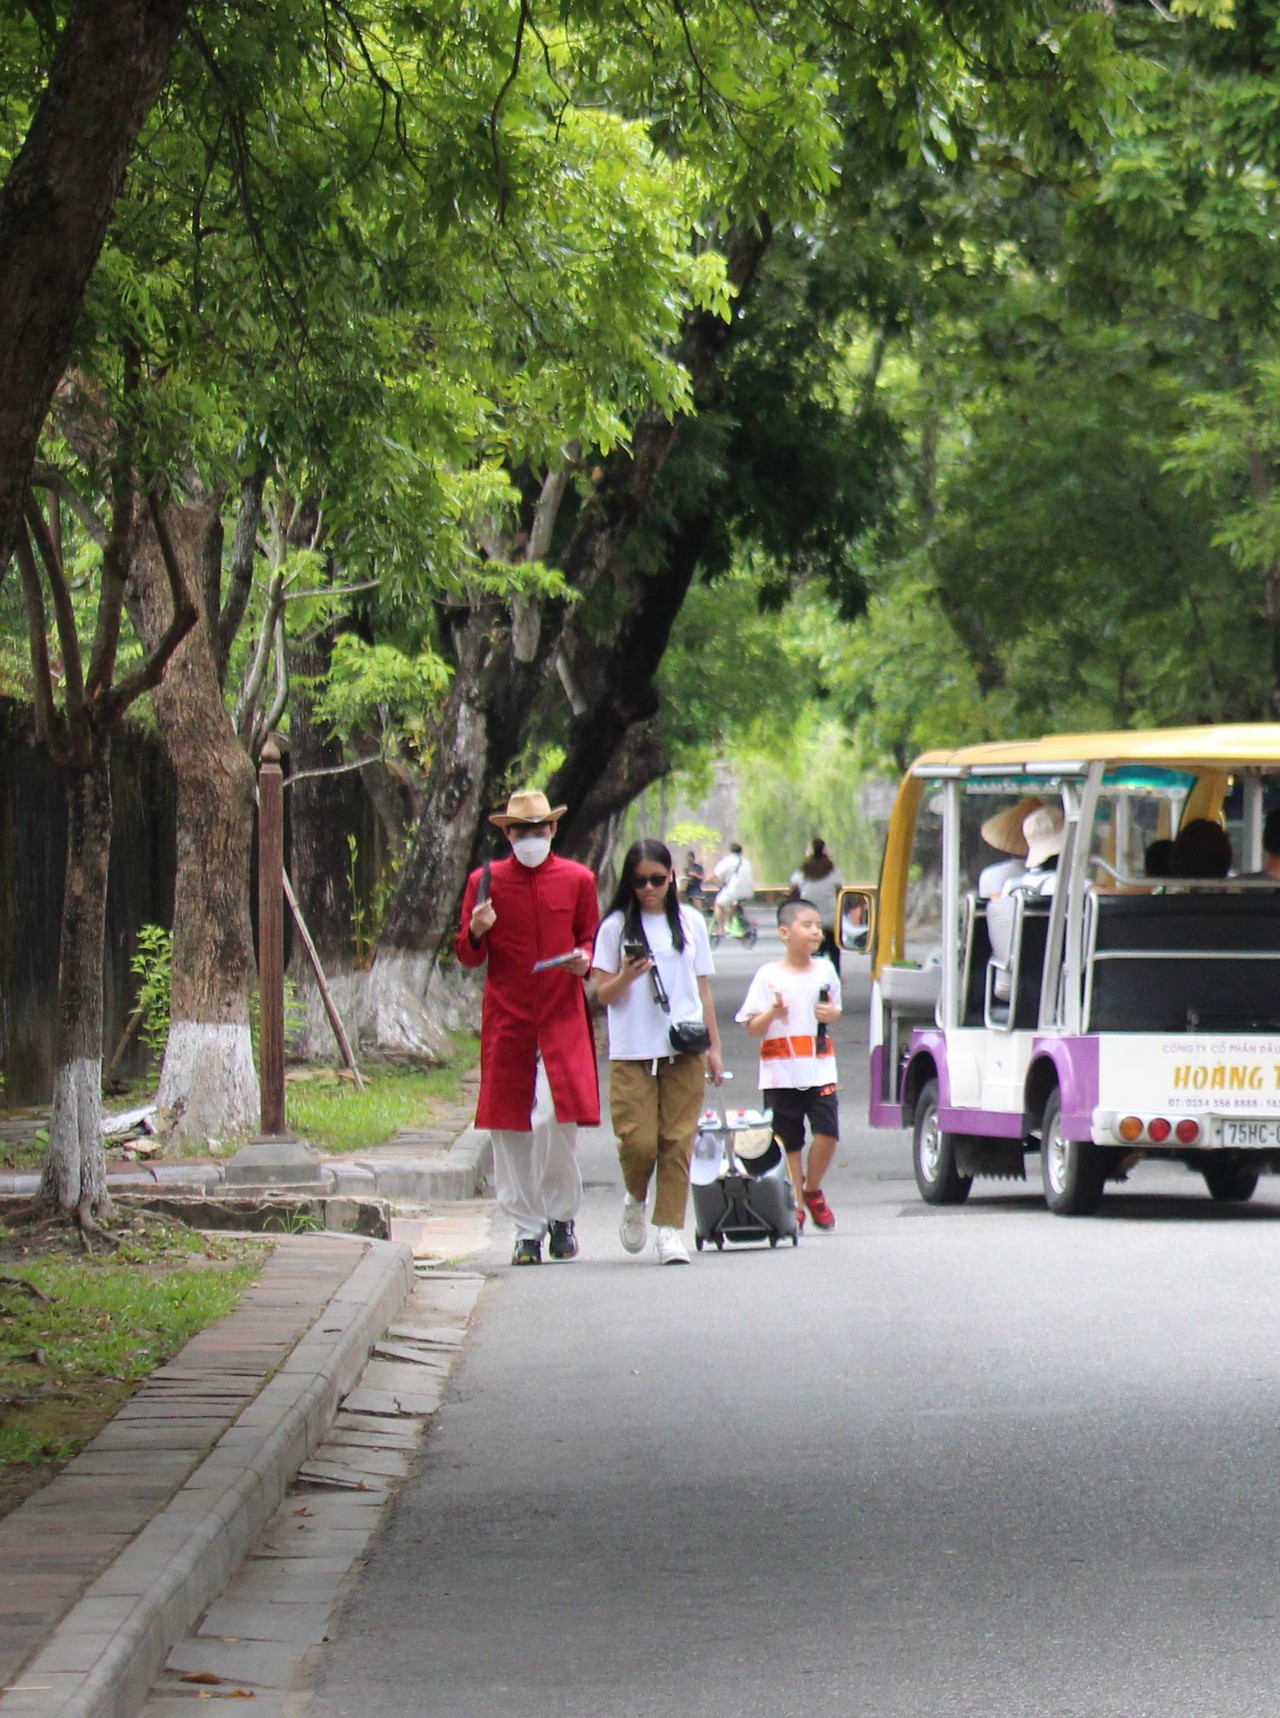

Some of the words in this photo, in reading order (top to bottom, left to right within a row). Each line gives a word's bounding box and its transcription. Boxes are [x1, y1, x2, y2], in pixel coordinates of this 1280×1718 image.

[1196, 1045, 1207, 1053] TY
[1173, 1060, 1263, 1090] HOÀNG
[1186, 1098, 1210, 1108] 0234
